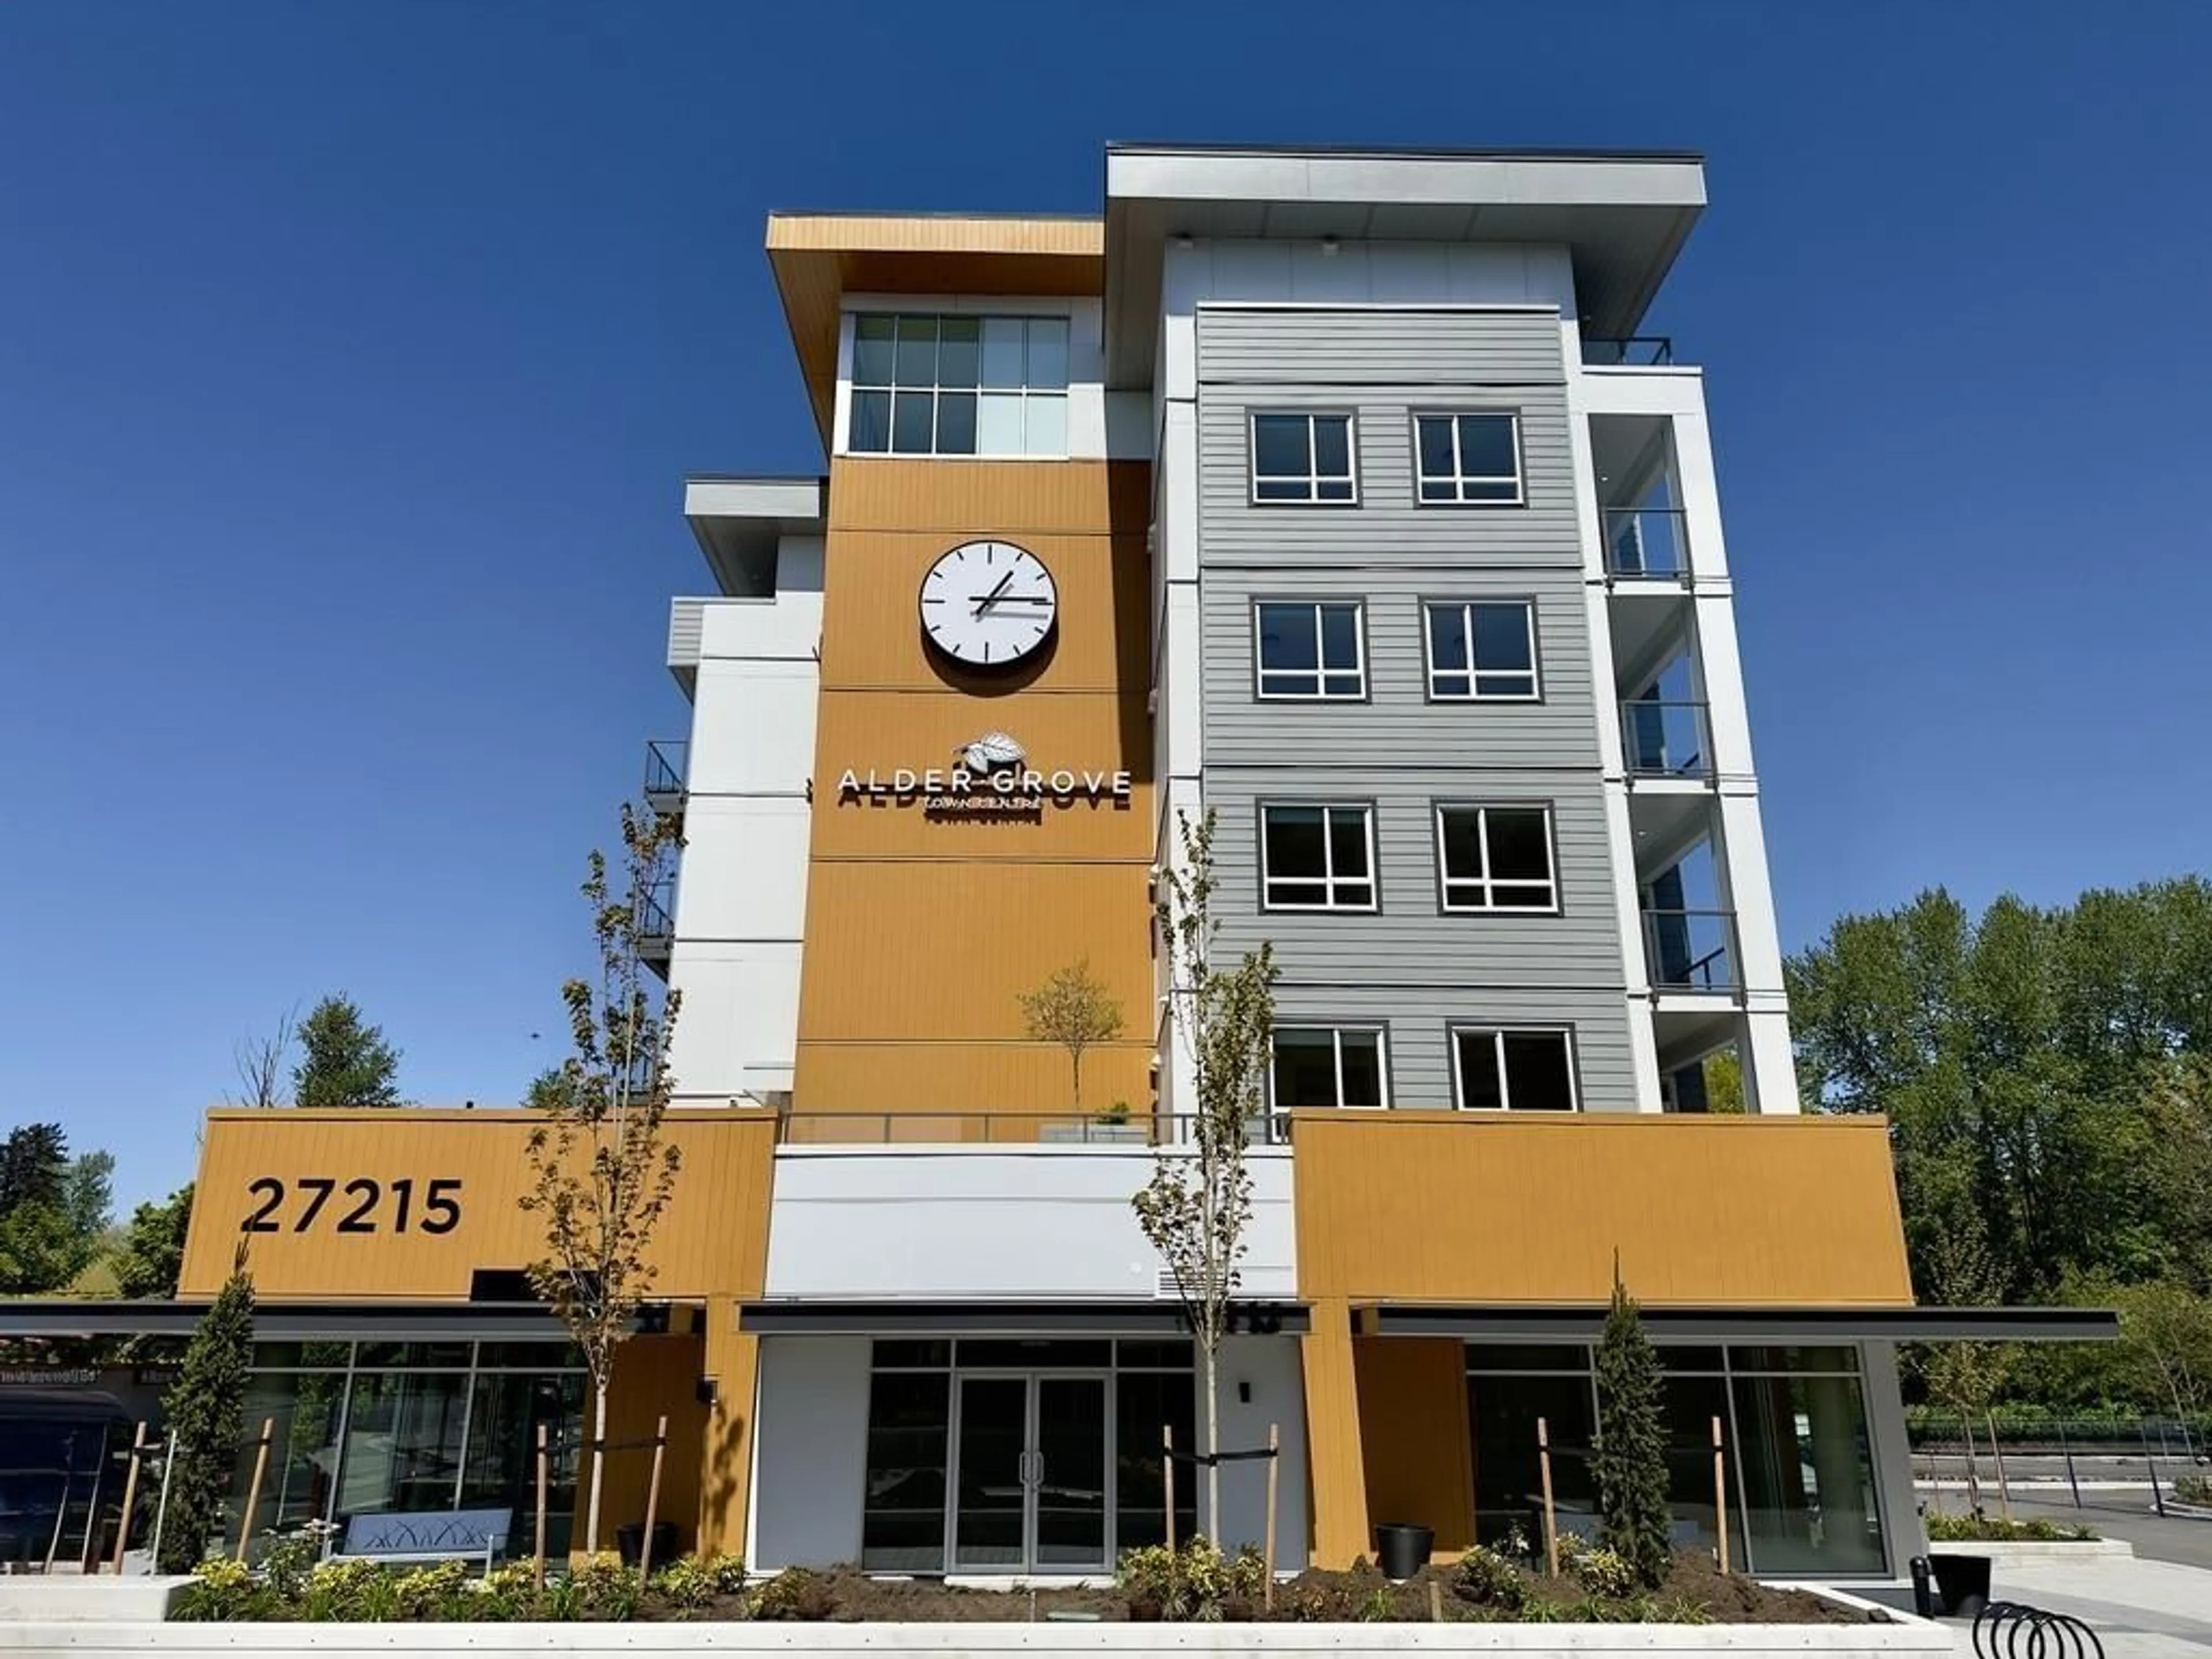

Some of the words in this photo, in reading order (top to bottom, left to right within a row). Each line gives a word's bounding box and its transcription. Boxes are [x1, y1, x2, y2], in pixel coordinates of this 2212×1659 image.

[838, 770, 972, 793] ALDER
[992, 770, 1131, 794] GROVE
[923, 796, 970, 809] TOWN
[240, 1177, 462, 1234] 27215
